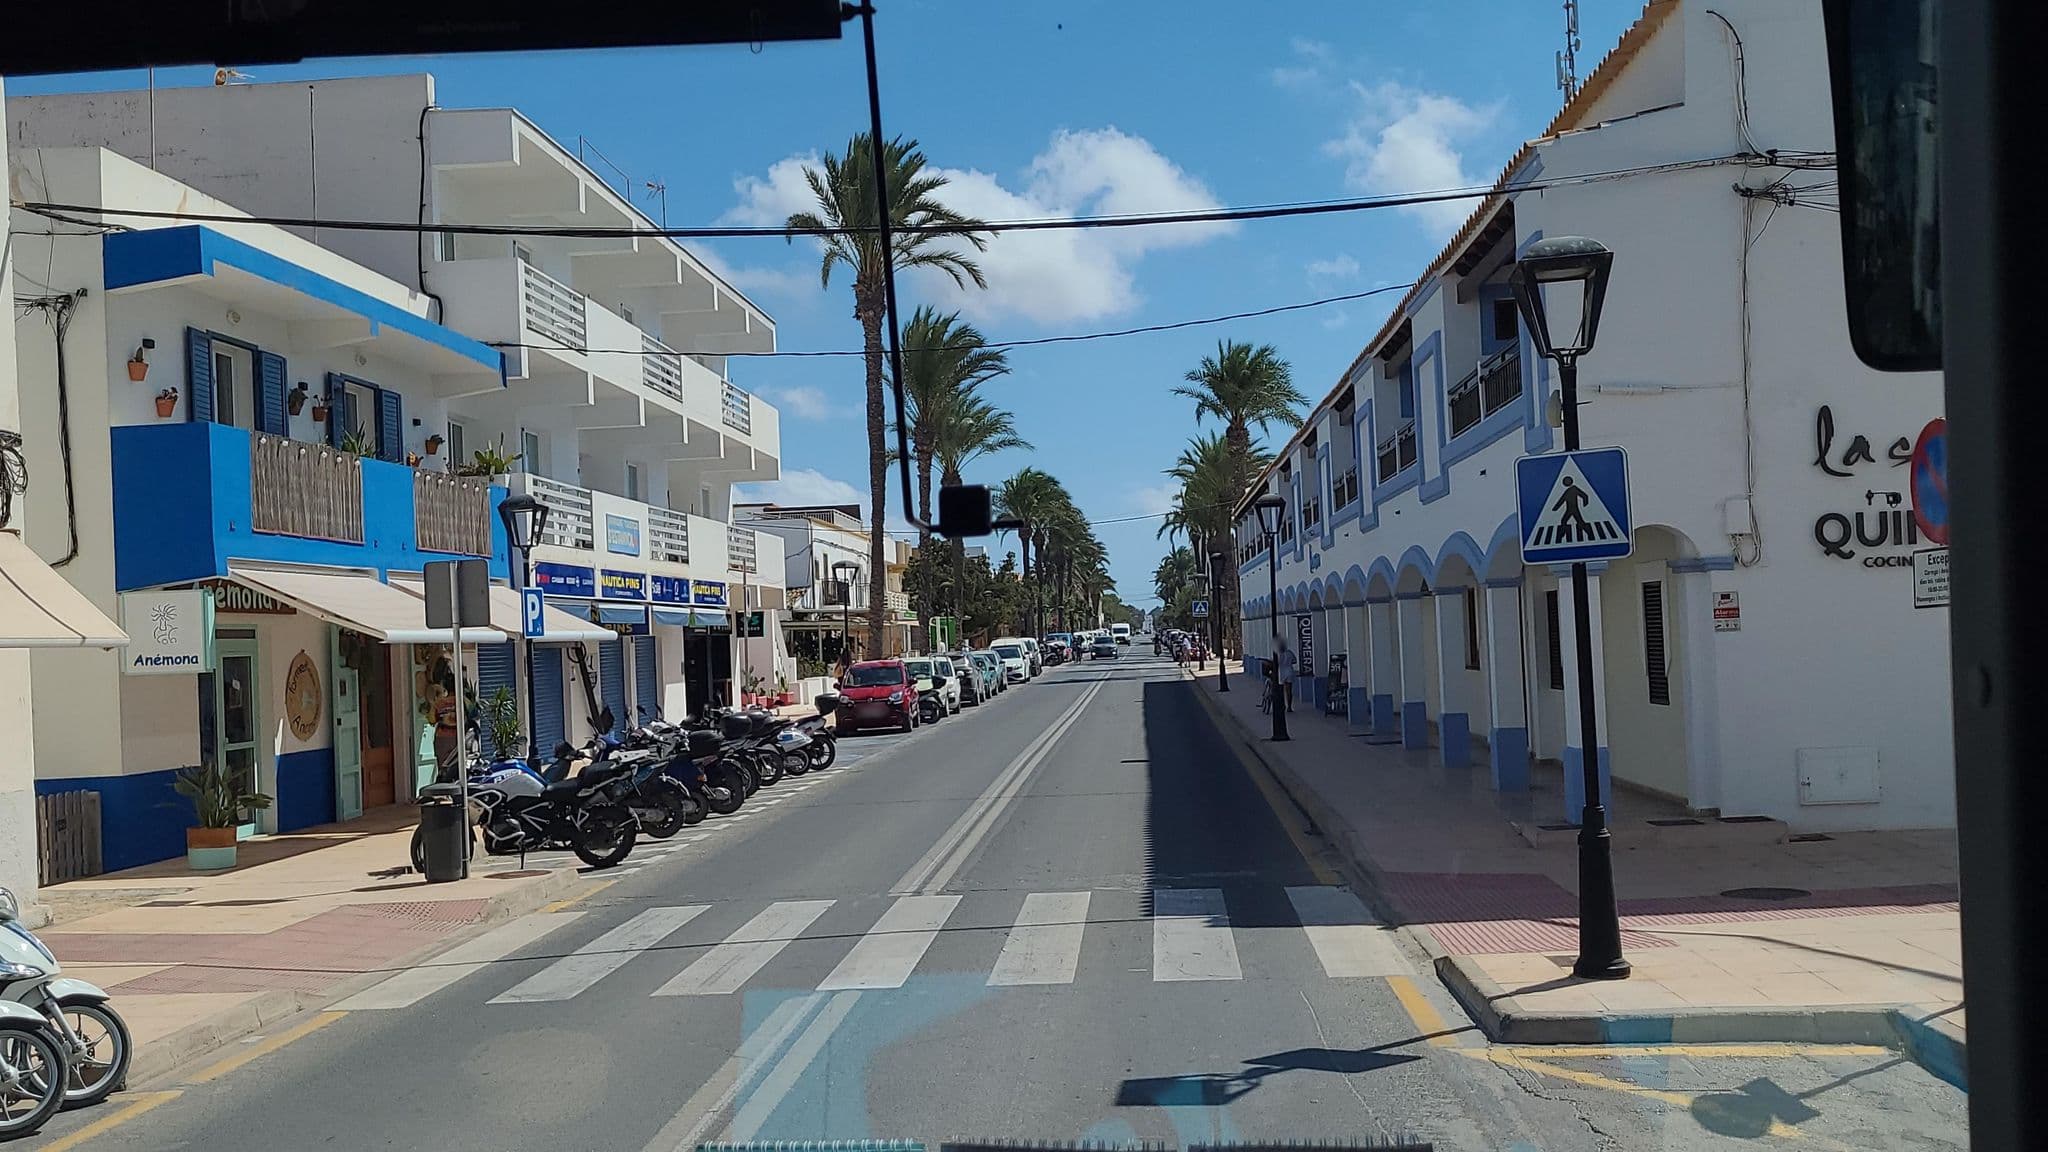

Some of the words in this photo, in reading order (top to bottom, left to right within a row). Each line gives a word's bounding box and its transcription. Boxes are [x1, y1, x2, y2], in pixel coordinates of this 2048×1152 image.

[527, 594, 539, 632] P
[134, 653, 199, 667] Anémona
[1300, 618, 1312, 672] QUIMERA
